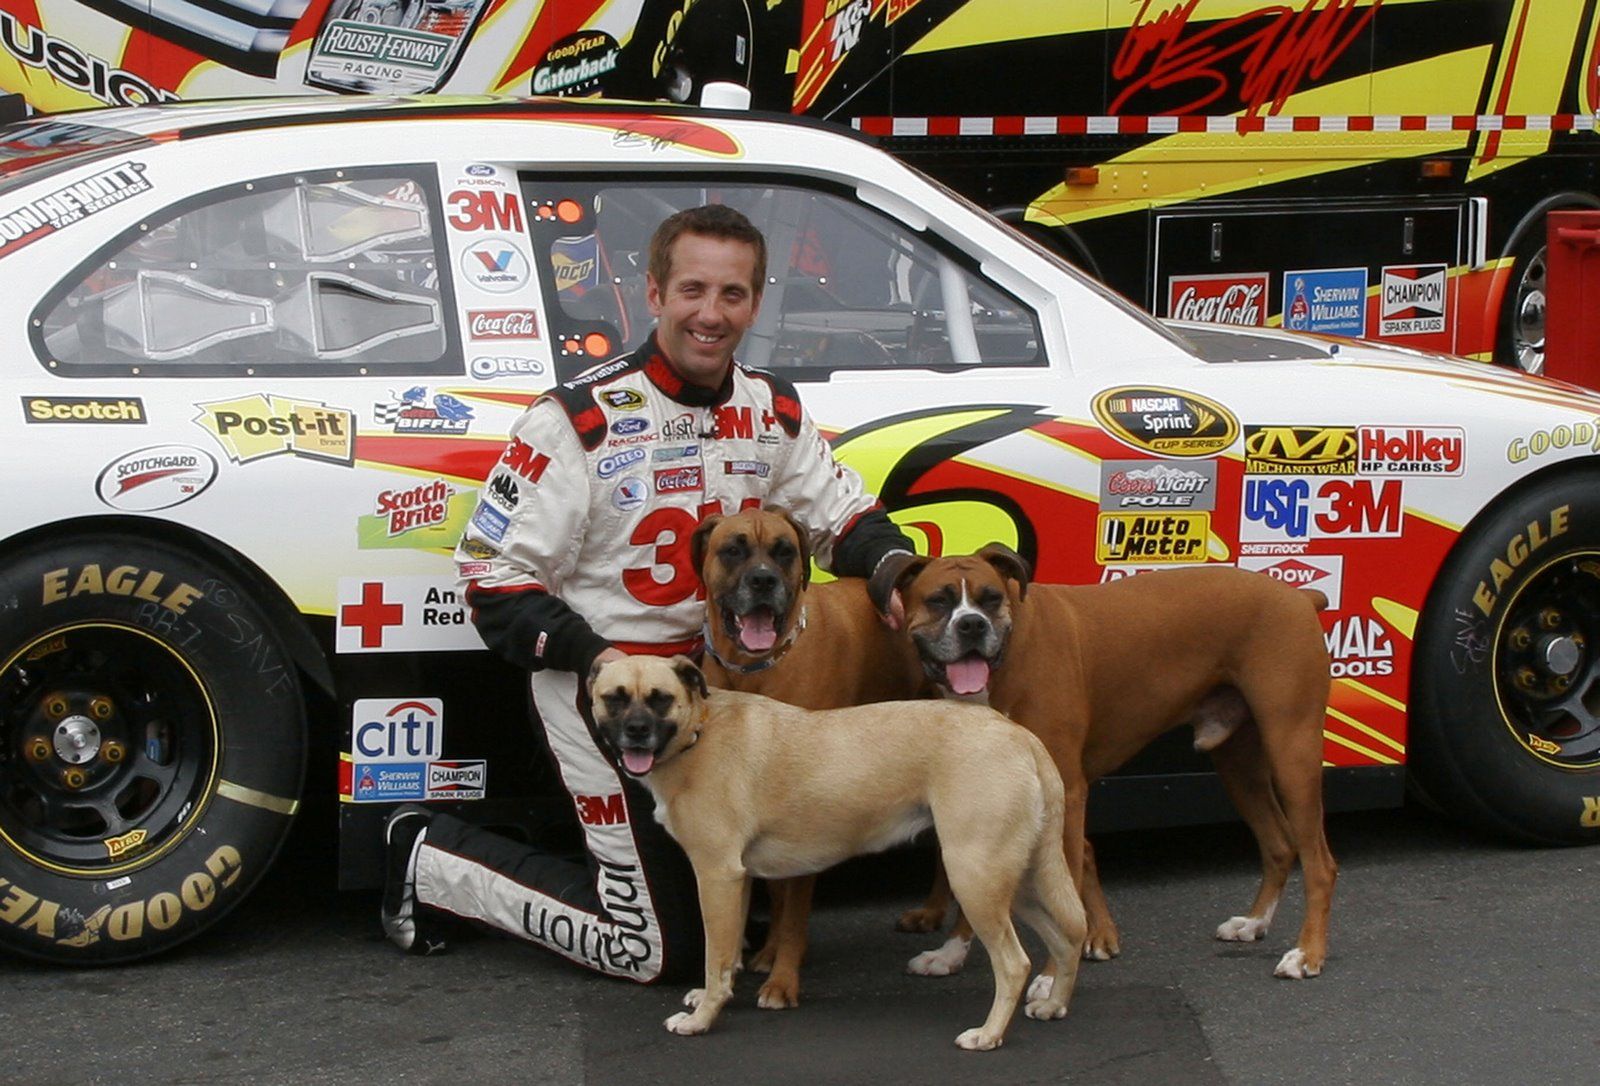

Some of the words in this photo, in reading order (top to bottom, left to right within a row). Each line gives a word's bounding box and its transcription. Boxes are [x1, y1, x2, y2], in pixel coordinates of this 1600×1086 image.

[324, 26, 381, 57] ROUSH
[379, 33, 445, 63] FENWAY
[547, 35, 605, 61] GOODYEAR
[0, 12, 181, 107] USIO
[342, 61, 404, 80] RACING
[533, 49, 619, 93] Gatorback
[469, 164, 492, 176] Ford
[457, 179, 507, 187] FUSION
[50, 209, 84, 229] TAX
[84, 180, 150, 213] SERVICE
[448, 190, 524, 233] 3M
[1312, 286, 1360, 303] SHERWIN
[1386, 281, 1441, 305] CHAMPION
[1311, 304, 1359, 321] WILLIAMS
[471, 313, 536, 337] Coca-Cola
[1384, 320, 1414, 334] SPARK
[1415, 318, 1442, 332] PLUGS
[471, 356, 544, 377] OREO
[30, 399, 142, 420] Scotch
[1131, 397, 1180, 413] NASCAR
[214, 411, 345, 437] Post-it
[712, 406, 753, 440] 3M
[1143, 413, 1193, 434] Sprint
[319, 438, 347, 447] Brand
[607, 432, 660, 448] RACING
[1153, 439, 1180, 450] CUP
[1182, 438, 1225, 449] SERIES
[1361, 428, 1463, 473] Holley
[117, 455, 199, 479] SCOTCHGARD
[501, 436, 552, 485] 3M
[598, 448, 645, 478] OREO
[1246, 458, 1315, 475] MECHANIX
[1316, 460, 1356, 475] WEAR
[1361, 462, 1382, 472] HP
[1387, 462, 1443, 473] CARBS
[1155, 473, 1209, 493] LIGHT
[1119, 495, 1194, 508] POLE
[1245, 479, 1310, 538] USG
[1314, 479, 1403, 534] 3M
[390, 501, 445, 535] Brite
[1128, 516, 1190, 536] Auto
[1120, 536, 1203, 558] Meter
[1241, 544, 1309, 555] SHEETROCK
[1472, 504, 1571, 618] EAGLE
[1268, 566, 1317, 584] DOW
[43, 563, 205, 616] EAGLE
[423, 607, 465, 625] Red
[356, 711, 439, 758] citi
[377, 780, 421, 791] WILLIAMS
[431, 769, 482, 783] CHAMPION
[457, 790, 483, 798] PLUGS
[576, 793, 629, 826] 3M
